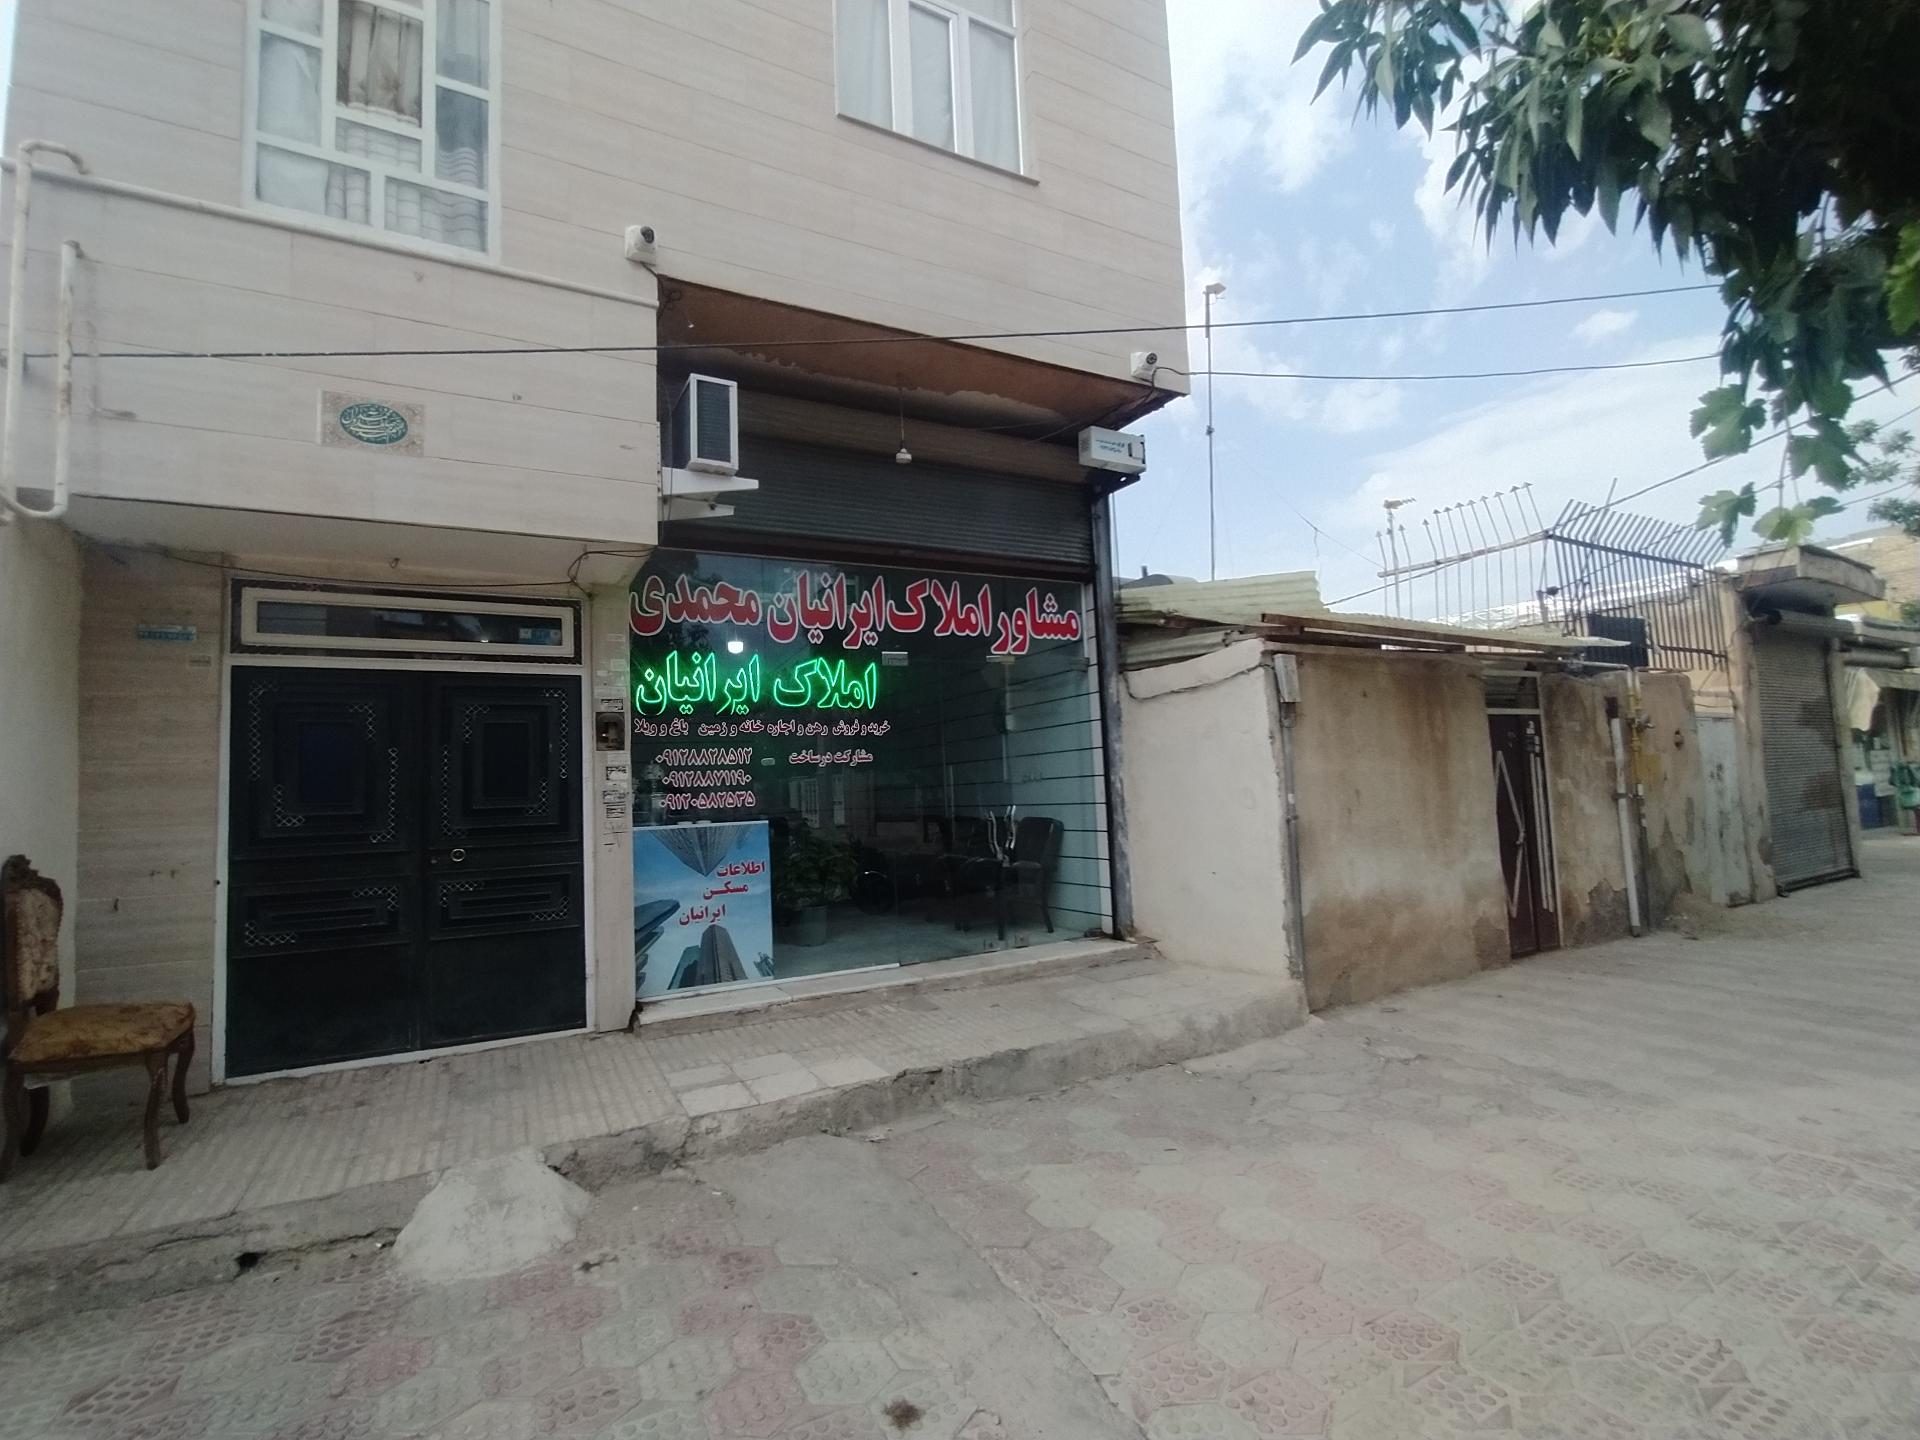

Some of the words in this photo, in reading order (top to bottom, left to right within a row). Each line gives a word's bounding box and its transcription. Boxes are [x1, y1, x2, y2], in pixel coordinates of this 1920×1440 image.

[629, 573, 762, 637] محمدی
[767, 571, 886, 649] ایرانیان
[888, 578, 991, 638] املاک
[990, 587, 1081, 655] مشاور
[635, 649, 761, 715] ایرانیان
[773, 657, 878, 711] املاک
[634, 718, 658, 736] ویلا
[659, 724, 668, 736] و
[669, 717, 689, 736] باغ
[698, 721, 728, 736] زمین
[729, 724, 738, 736] و
[739, 719, 765, 733] خانه
[767, 719, 796, 737] اجاره
[797, 724, 805, 736] و
[805, 721, 829, 736] رهن
[832, 719, 860, 736] فروش
[860, 725, 868, 736] و
[867, 720, 891, 736] خرید
[655, 747, 753, 766] ۰۹۱۲۸۸۲۸۵۱۲
[834, 749, 874, 766] مشارکت
[661, 769, 752, 787] ۰۹۱۲۸۸۷۱۱۹۰
[660, 791, 756, 810] ۰۹۱۲۰۵۸۲۵۳۵
[716, 860, 766, 878] اطلاعات
[703, 881, 749, 900] مسکن
[678, 904, 727, 926] ایرانیان
